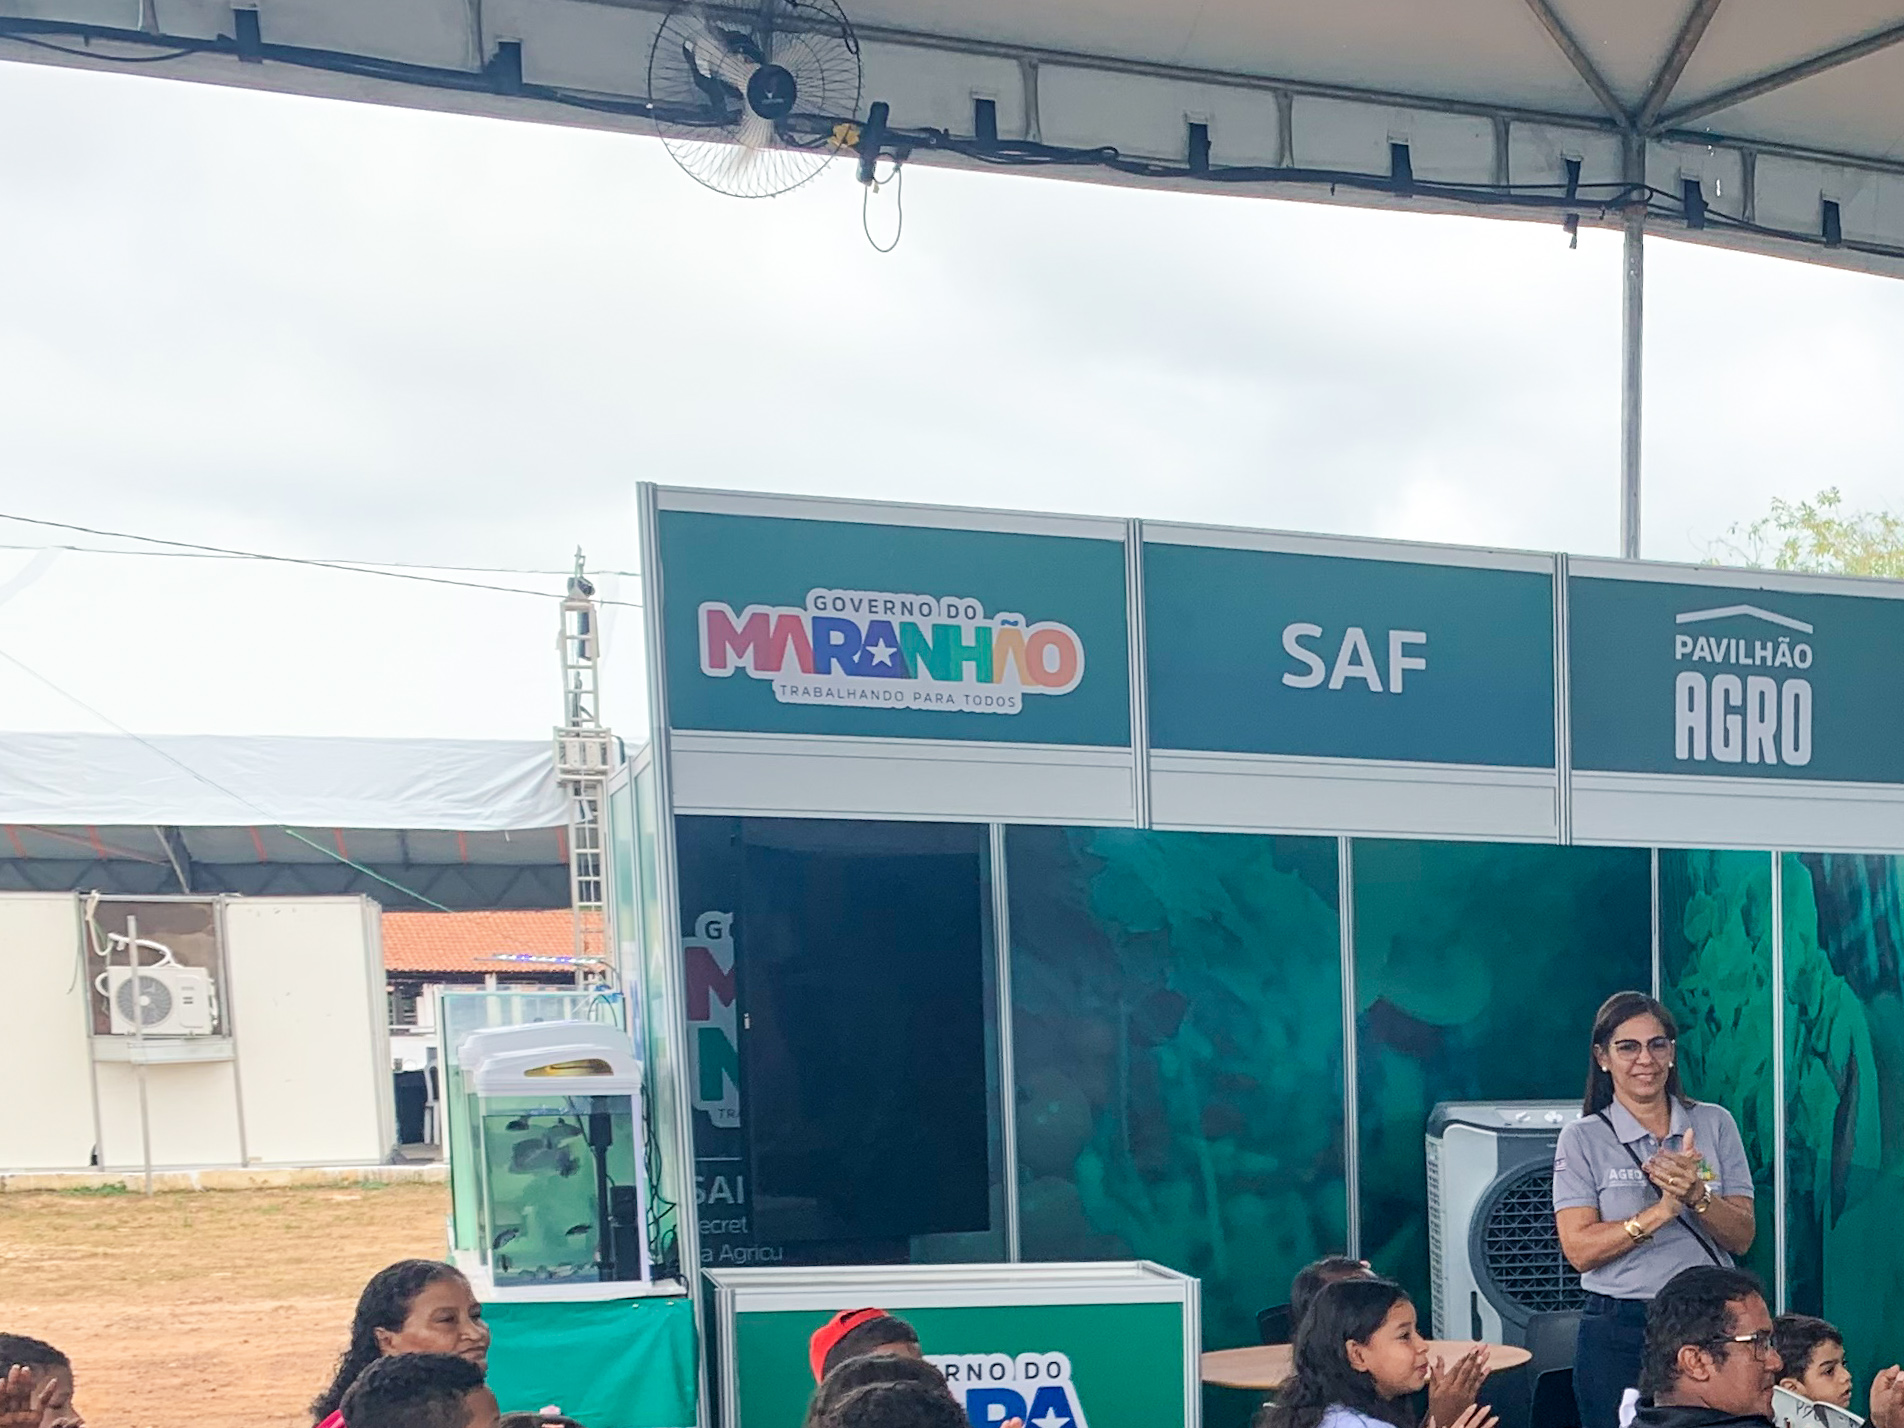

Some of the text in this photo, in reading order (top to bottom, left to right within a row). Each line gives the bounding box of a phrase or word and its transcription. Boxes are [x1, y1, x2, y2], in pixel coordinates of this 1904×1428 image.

[813, 595, 978, 620] GOVERNO DO
[706, 609, 1077, 688] MARANHÃO
[1281, 622, 1428, 694] SAF
[1674, 634, 1813, 670] PAVILHÃO
[779, 684, 1017, 709] TRABALHANDO PARA TODOS
[1674, 671, 1812, 767] AGRO
[1608, 1168, 1643, 1180] AGED
[1024, 1361, 1062, 1380] DO
